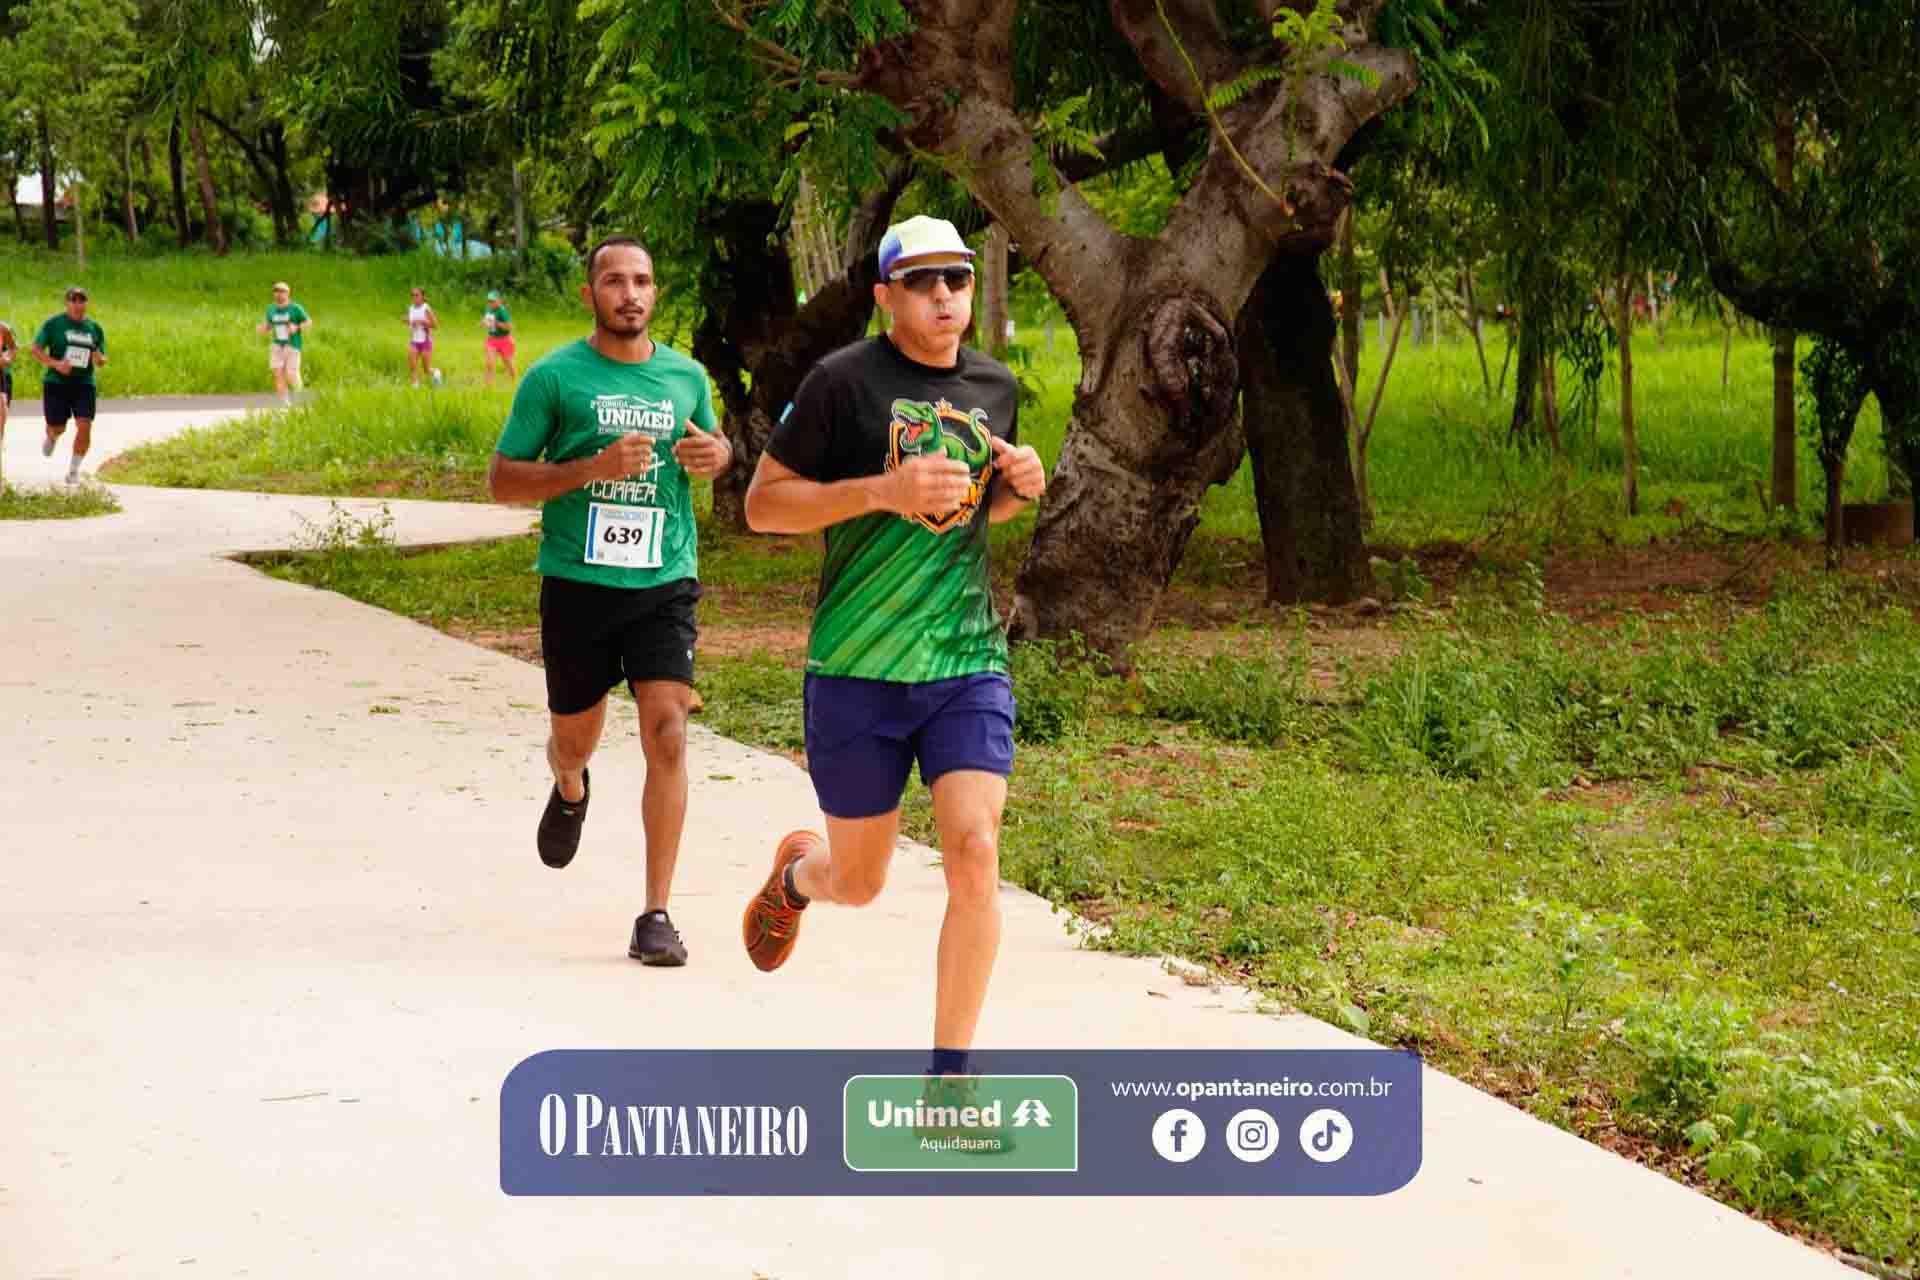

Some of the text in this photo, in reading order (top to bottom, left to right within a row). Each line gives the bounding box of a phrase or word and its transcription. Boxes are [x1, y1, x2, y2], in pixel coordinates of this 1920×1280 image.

[598, 408, 675, 430] UNIMED
[592, 479, 657, 504] CORRER
[603, 525, 643, 545] 639
